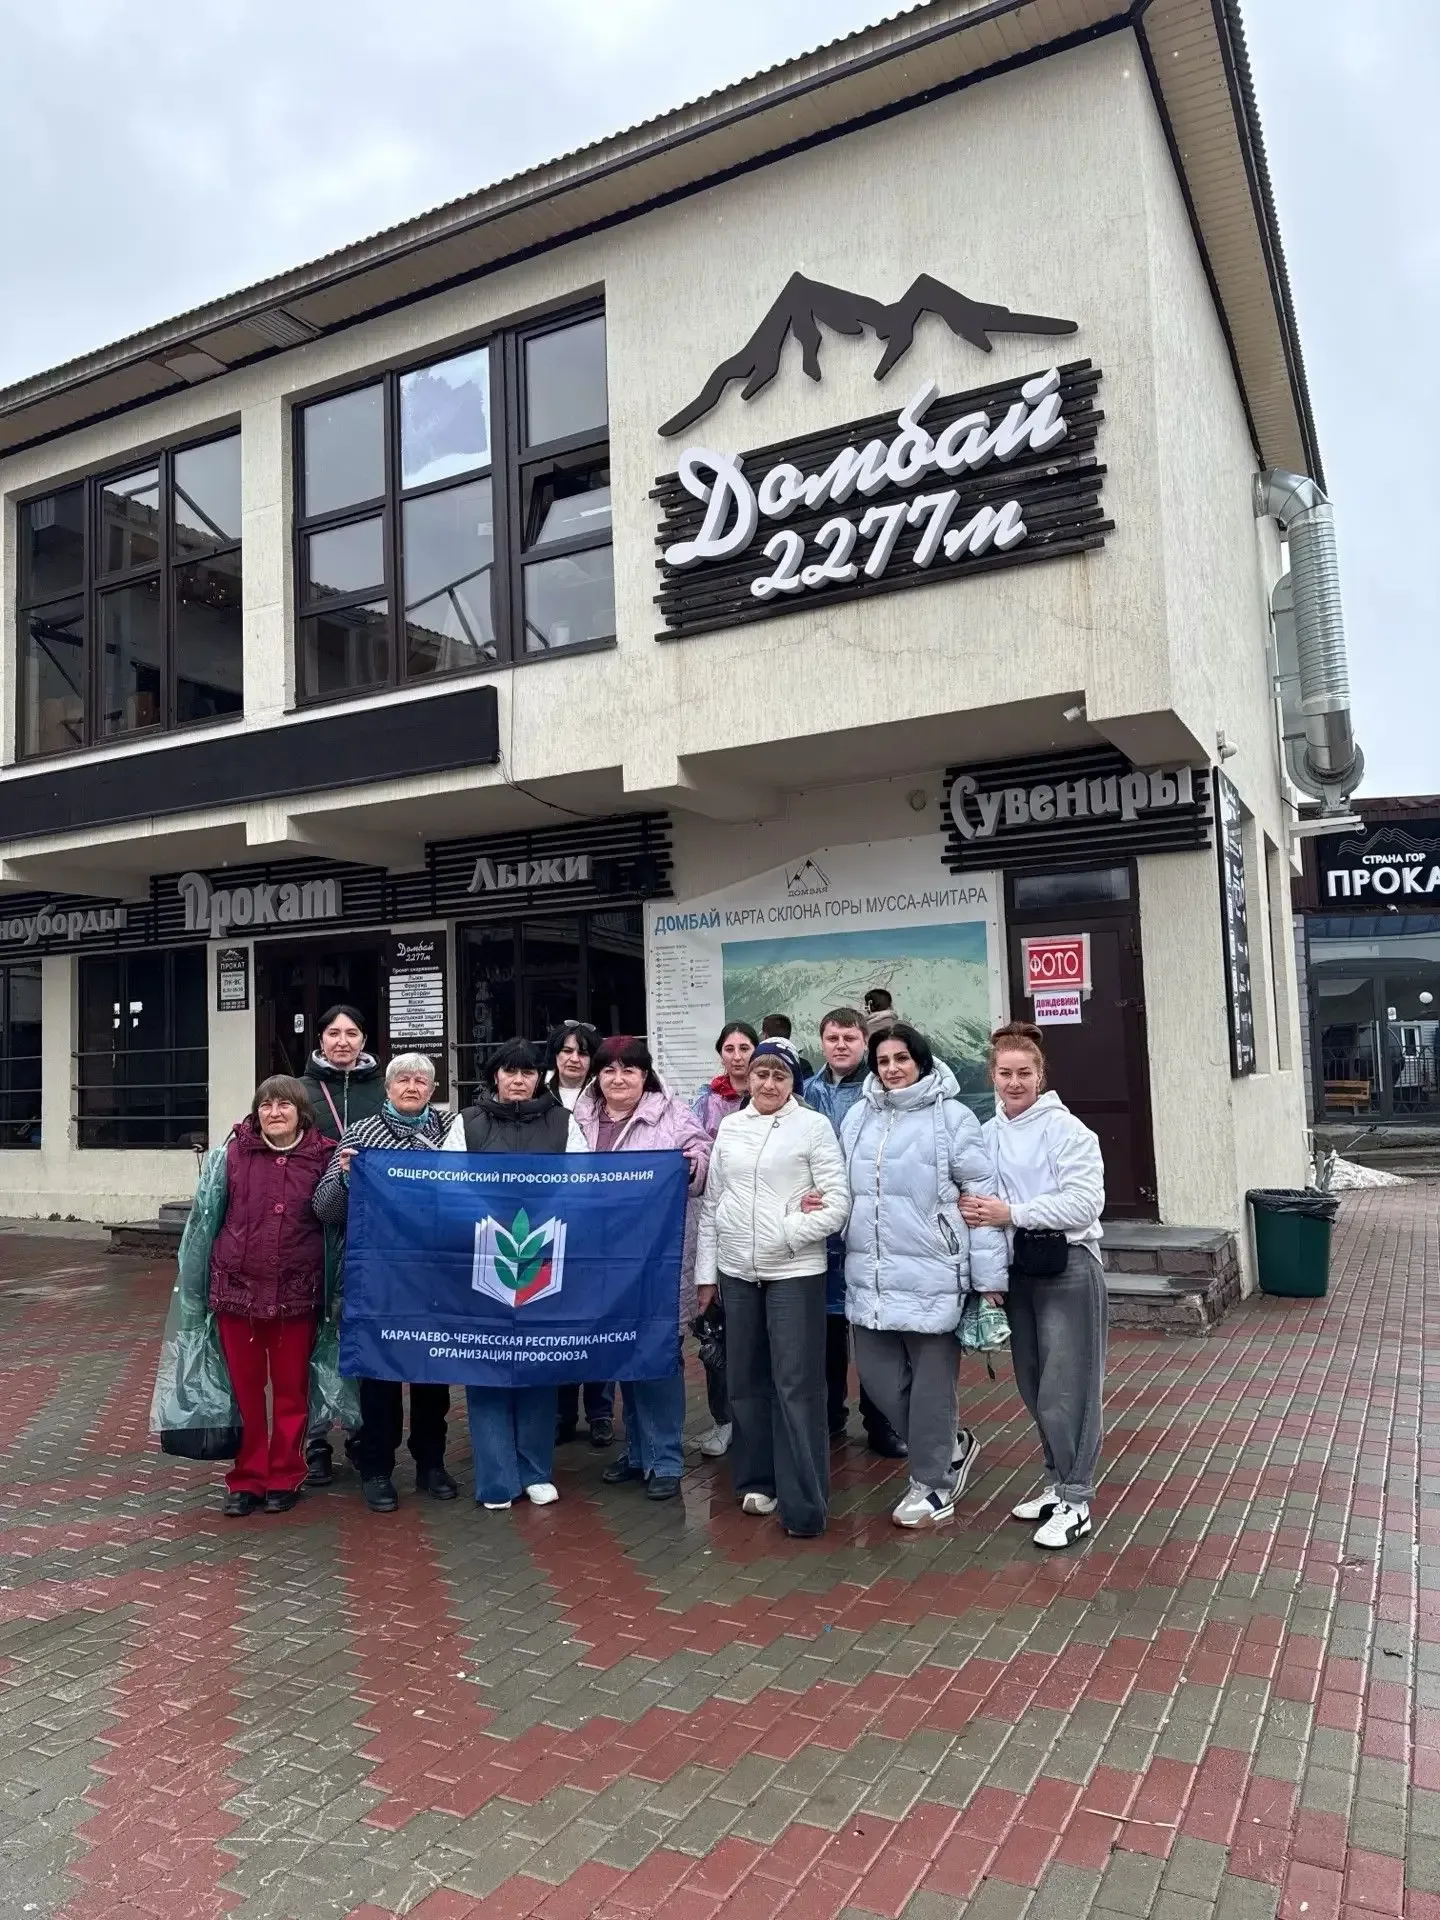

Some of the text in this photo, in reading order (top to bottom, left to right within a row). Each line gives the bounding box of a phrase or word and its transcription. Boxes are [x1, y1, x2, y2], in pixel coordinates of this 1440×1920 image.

[664, 367, 1068, 567] Домбай
[750, 489, 1028, 600] 2277м
[950, 765, 1196, 841] Сувениры
[1362, 852, 1426, 865] СТРАНА ГОР
[467, 854, 593, 893] Лыжи
[178, 871, 343, 938] Прокат
[654, 891, 988, 935] ДОМБАЙ КАРТА СКЛОНА ГОРЫ МУССА-АЧИТАРА
[396, 940, 435, 957] Домбай
[220, 961, 246, 970] ПРОКАТ
[1029, 950, 1079, 977] ФОТО
[387, 1167, 654, 1184] ОБЩЕРОССИЙСКИЙ ПРОФСОЮЗ ОБРАЗОВАНИЯ
[381, 1329, 637, 1347] КАРАЧАЕВО-ЧЕРКЕССКАЯ РЕСПУБЛИКАНСКАЯ
[429, 1347, 588, 1362] ОРГАНИЗАЦИЯ ПРОФСОЮЗА
